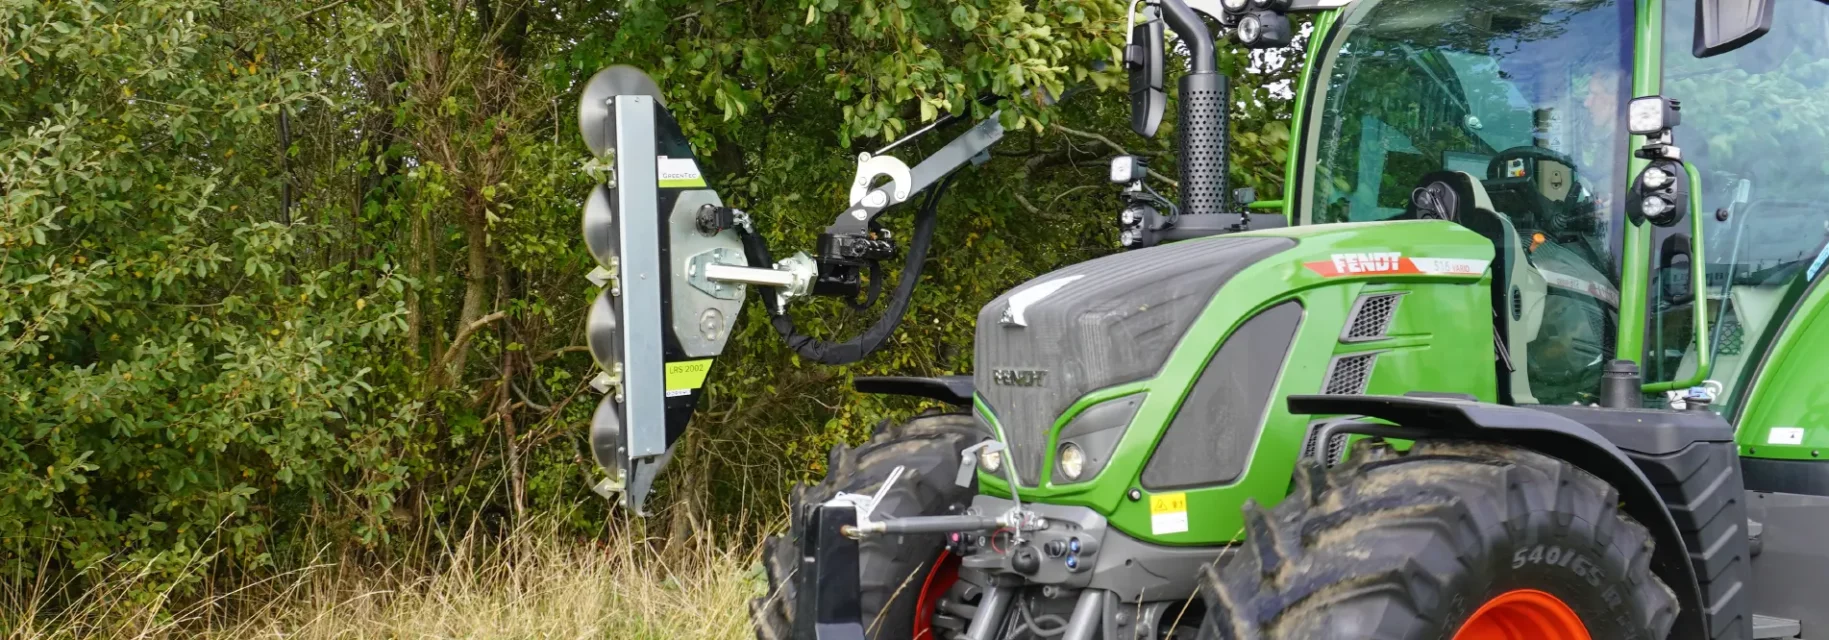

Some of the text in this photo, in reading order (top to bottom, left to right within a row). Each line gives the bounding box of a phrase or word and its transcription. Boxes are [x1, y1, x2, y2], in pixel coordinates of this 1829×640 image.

[1331, 252, 1401, 273] FENDT
[1452, 264, 1470, 273] VARIO
[669, 364, 704, 375] LRS 2002
[993, 368, 1048, 387] FENDT
[1512, 545, 1604, 587] 540/65
